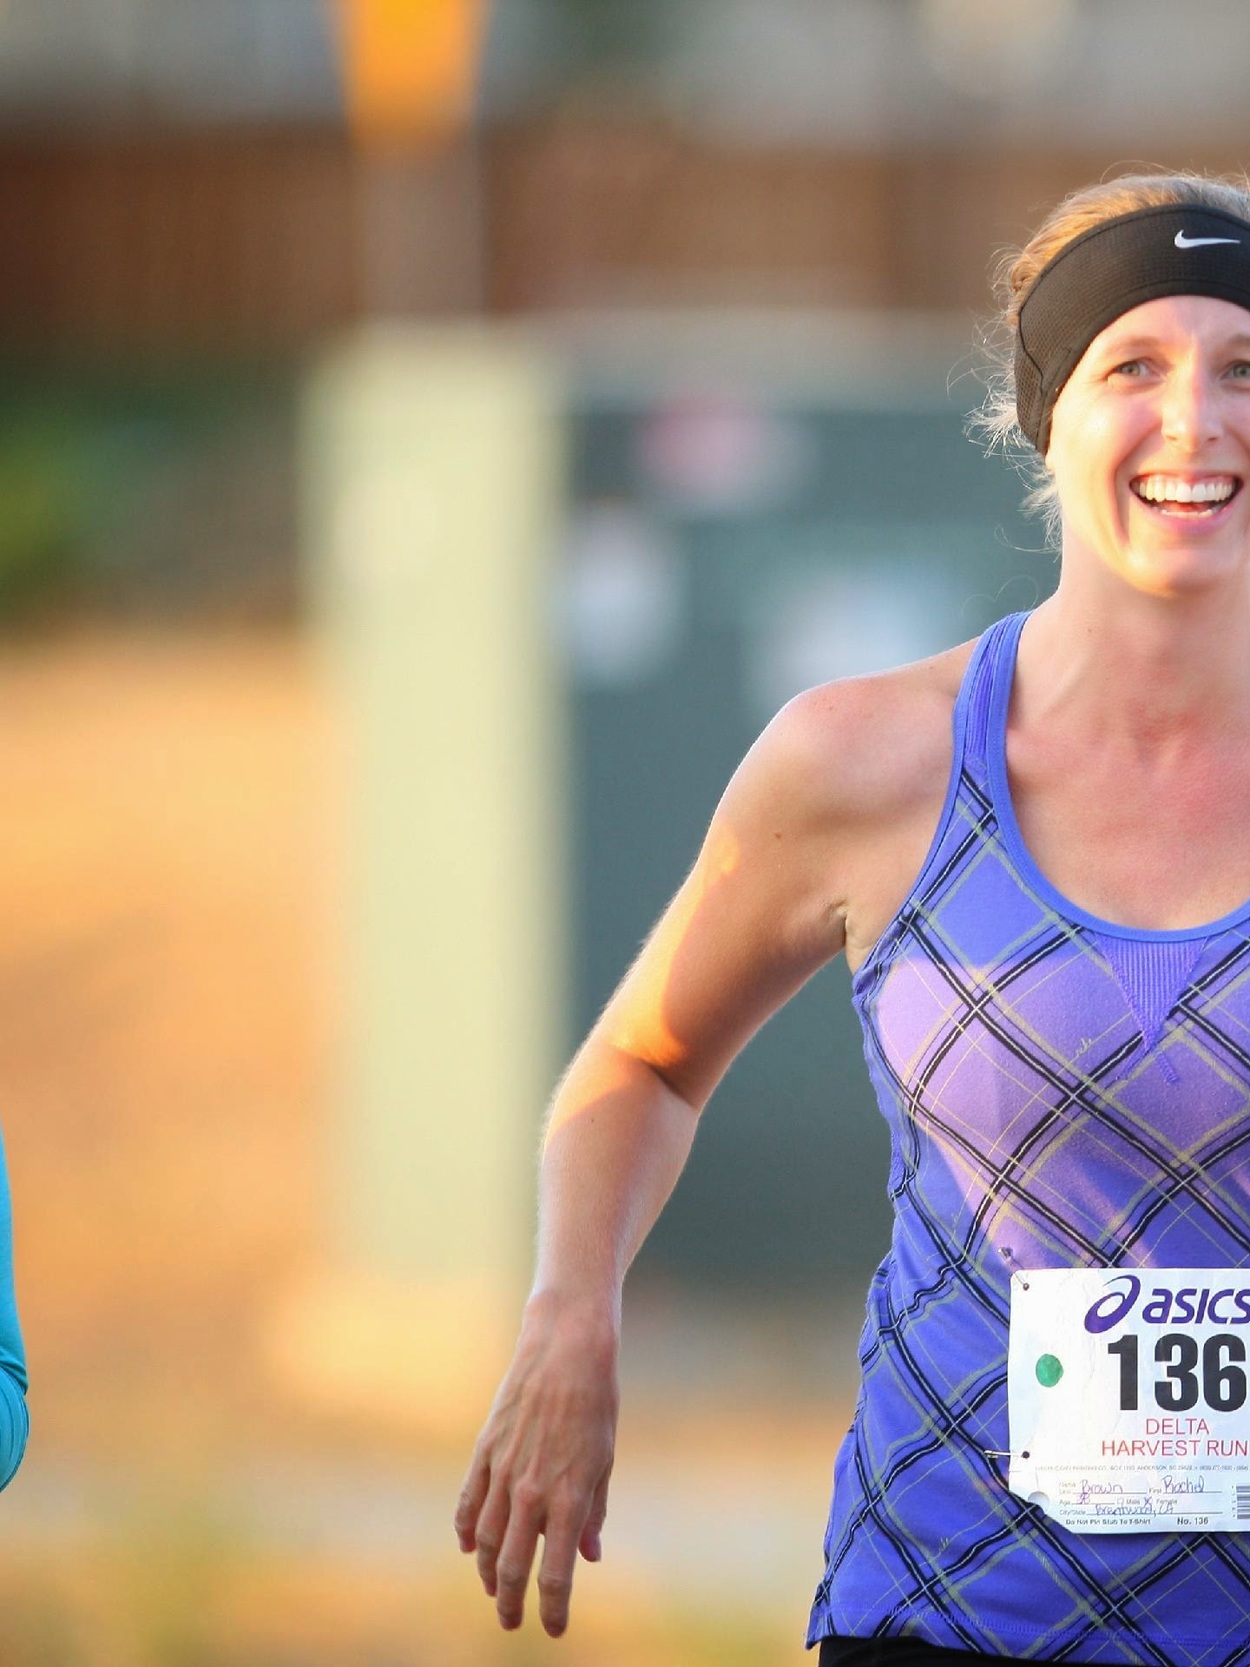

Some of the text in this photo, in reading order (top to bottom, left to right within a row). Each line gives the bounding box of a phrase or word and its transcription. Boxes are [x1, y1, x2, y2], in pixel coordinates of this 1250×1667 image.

[1108, 1333, 1247, 1412] 136
[1146, 1418, 1210, 1435] DELTA
[1101, 1439, 1248, 1457] HARVEST RUN
[1080, 1479, 1123, 1494] Brown
[1177, 1517, 1209, 1525] No. 136
